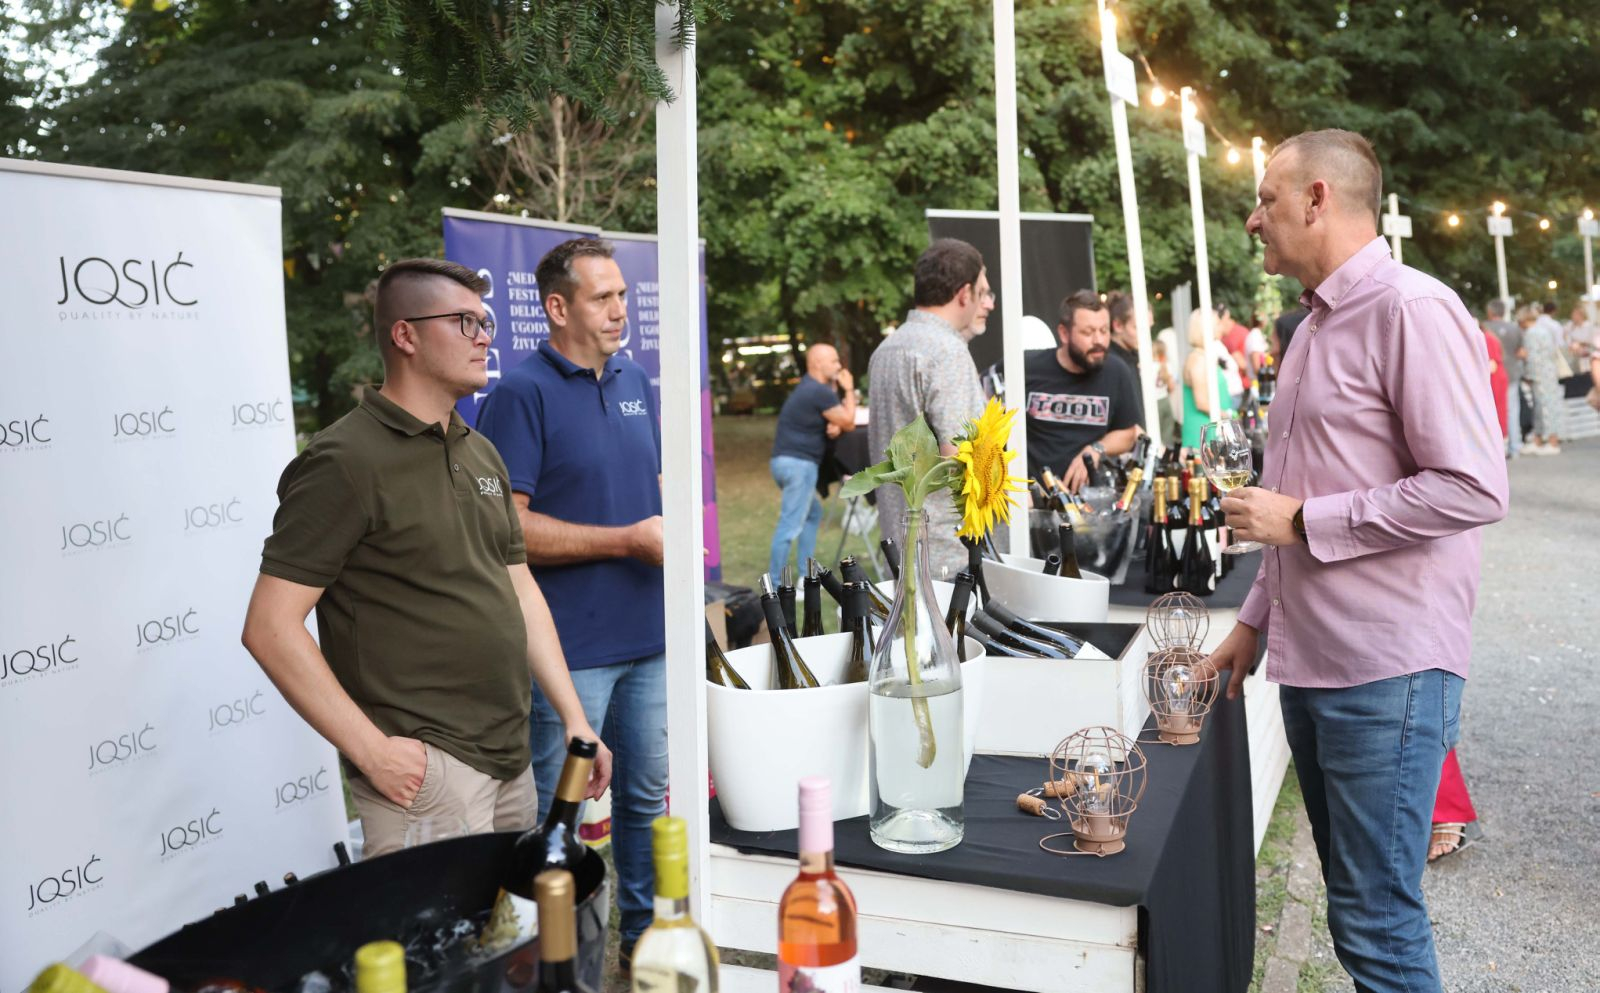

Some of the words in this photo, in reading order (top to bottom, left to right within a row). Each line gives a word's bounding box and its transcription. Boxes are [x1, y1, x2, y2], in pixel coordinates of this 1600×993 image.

[58, 310, 121, 322] QUALITY
[129, 311, 142, 320] BY
[151, 311, 200, 320] NATURE
